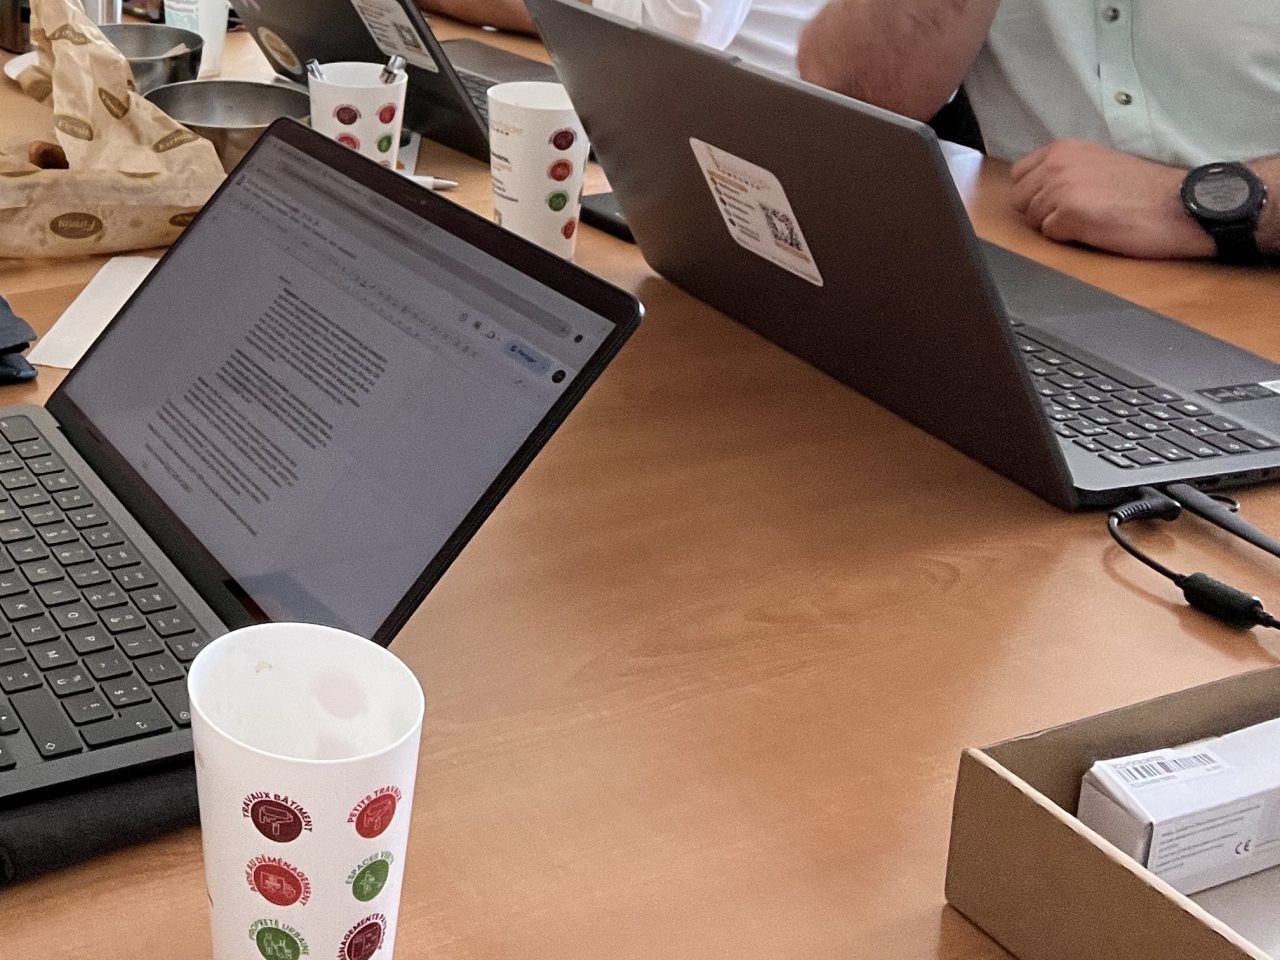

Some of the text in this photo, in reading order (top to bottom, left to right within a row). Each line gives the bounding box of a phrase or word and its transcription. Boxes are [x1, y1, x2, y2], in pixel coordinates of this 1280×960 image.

[242, 791, 313, 832] TRAVAUX BÂTIMENT
[347, 795, 373, 823] PETITS
[1235, 839, 1251, 855] CE
[245, 854, 312, 906] AIDE AU DÉMÉNAGEMENT
[345, 852, 379, 885] ESPACES
[282, 923, 310, 956] URBAINE
